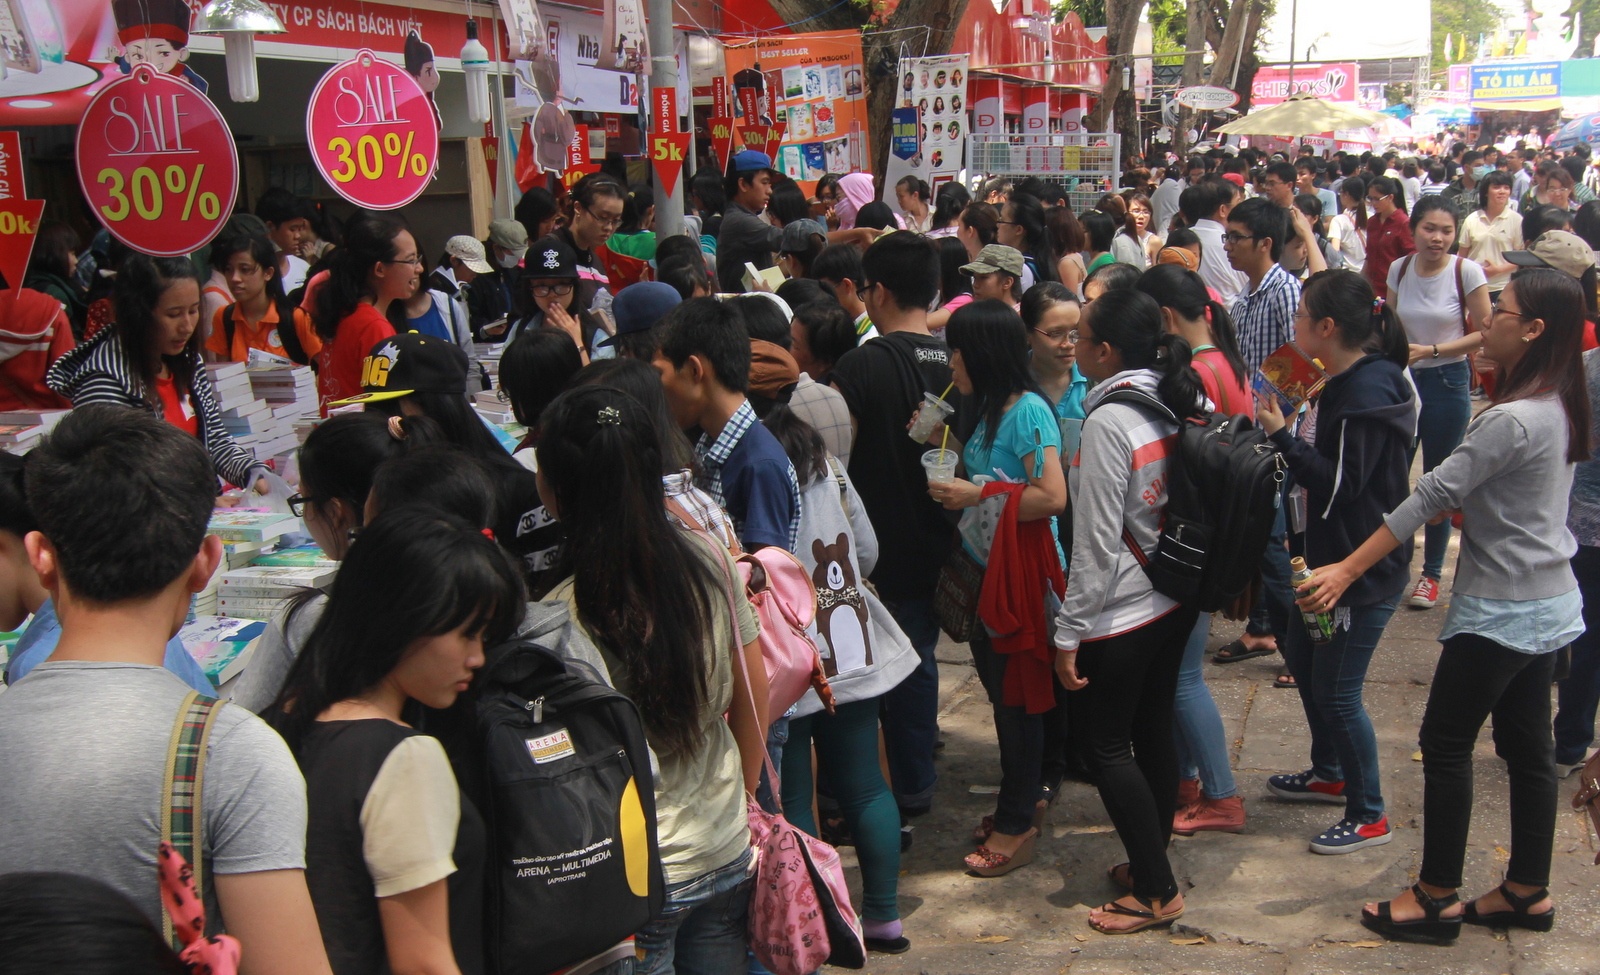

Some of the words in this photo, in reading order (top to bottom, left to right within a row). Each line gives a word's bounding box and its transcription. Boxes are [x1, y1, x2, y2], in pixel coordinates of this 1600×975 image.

[293, 6, 312, 27] CP
[317, 7, 355, 32] SÁCH
[358, 12, 395, 36] BÁCH
[577, 34, 600, 60] Nhà
[1506, 75, 1525, 88] IN
[334, 74, 402, 124] SALE
[1205, 92, 1234, 101] COMICS
[661, 94, 671, 118] ĐỒNG
[104, 93, 191, 154] SALE
[662, 120, 671, 133] GIÁ
[712, 124, 730, 139] 40k
[743, 131, 765, 145] 30k
[328, 131, 428, 183] 30%
[654, 138, 683, 161] 5k
[572, 152, 583, 166] GIÁ
[565, 171, 589, 187] 10
[97, 163, 221, 222] 30%
[530, 732, 567, 749] ARENA
[534, 742, 570, 756] MULTIMEDIA
[517, 866, 551, 878] ARENA
[562, 849, 612, 873] MULTIMEDIA
[547, 871, 587, 885] (APROTRAIN)
